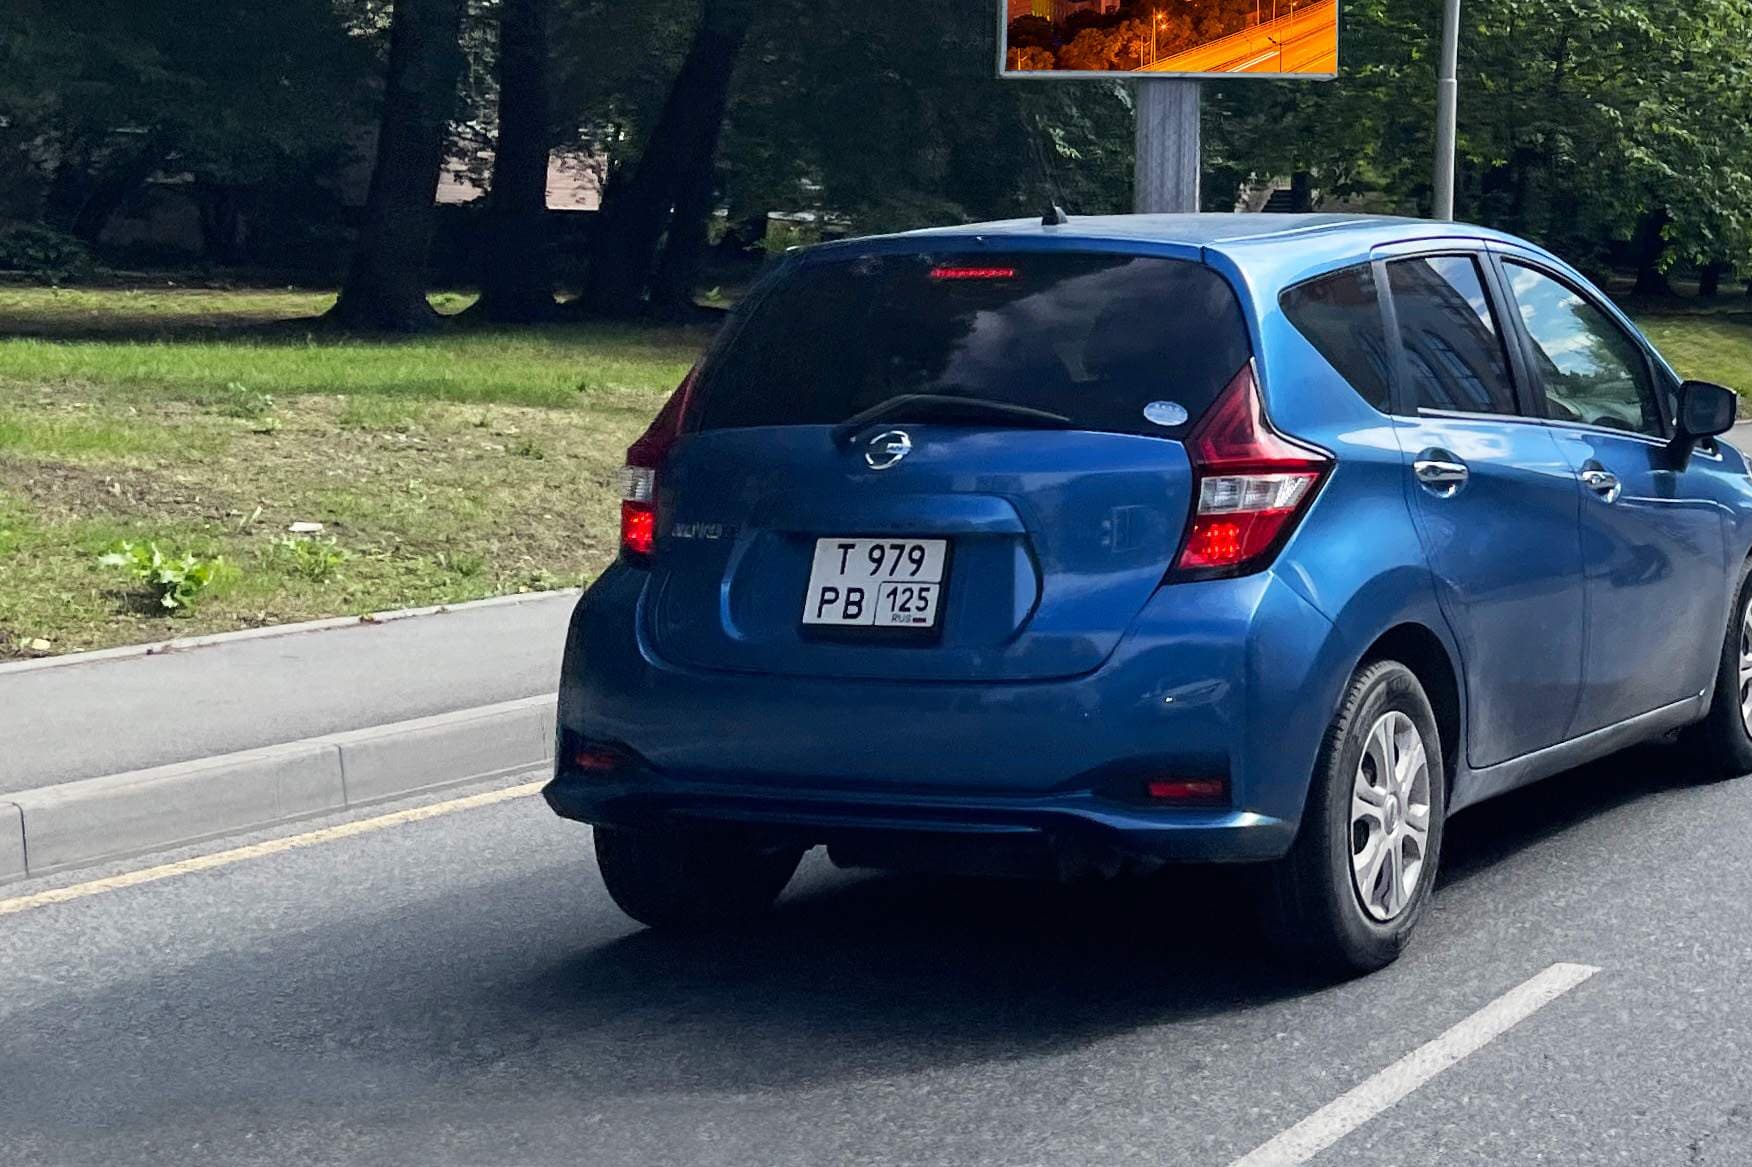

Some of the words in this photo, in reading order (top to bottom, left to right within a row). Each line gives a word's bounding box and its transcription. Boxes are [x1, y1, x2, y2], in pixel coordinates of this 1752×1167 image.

[868, 543, 925, 577] 979
[886, 586, 931, 612] 125
[891, 614, 912, 623] RUS
